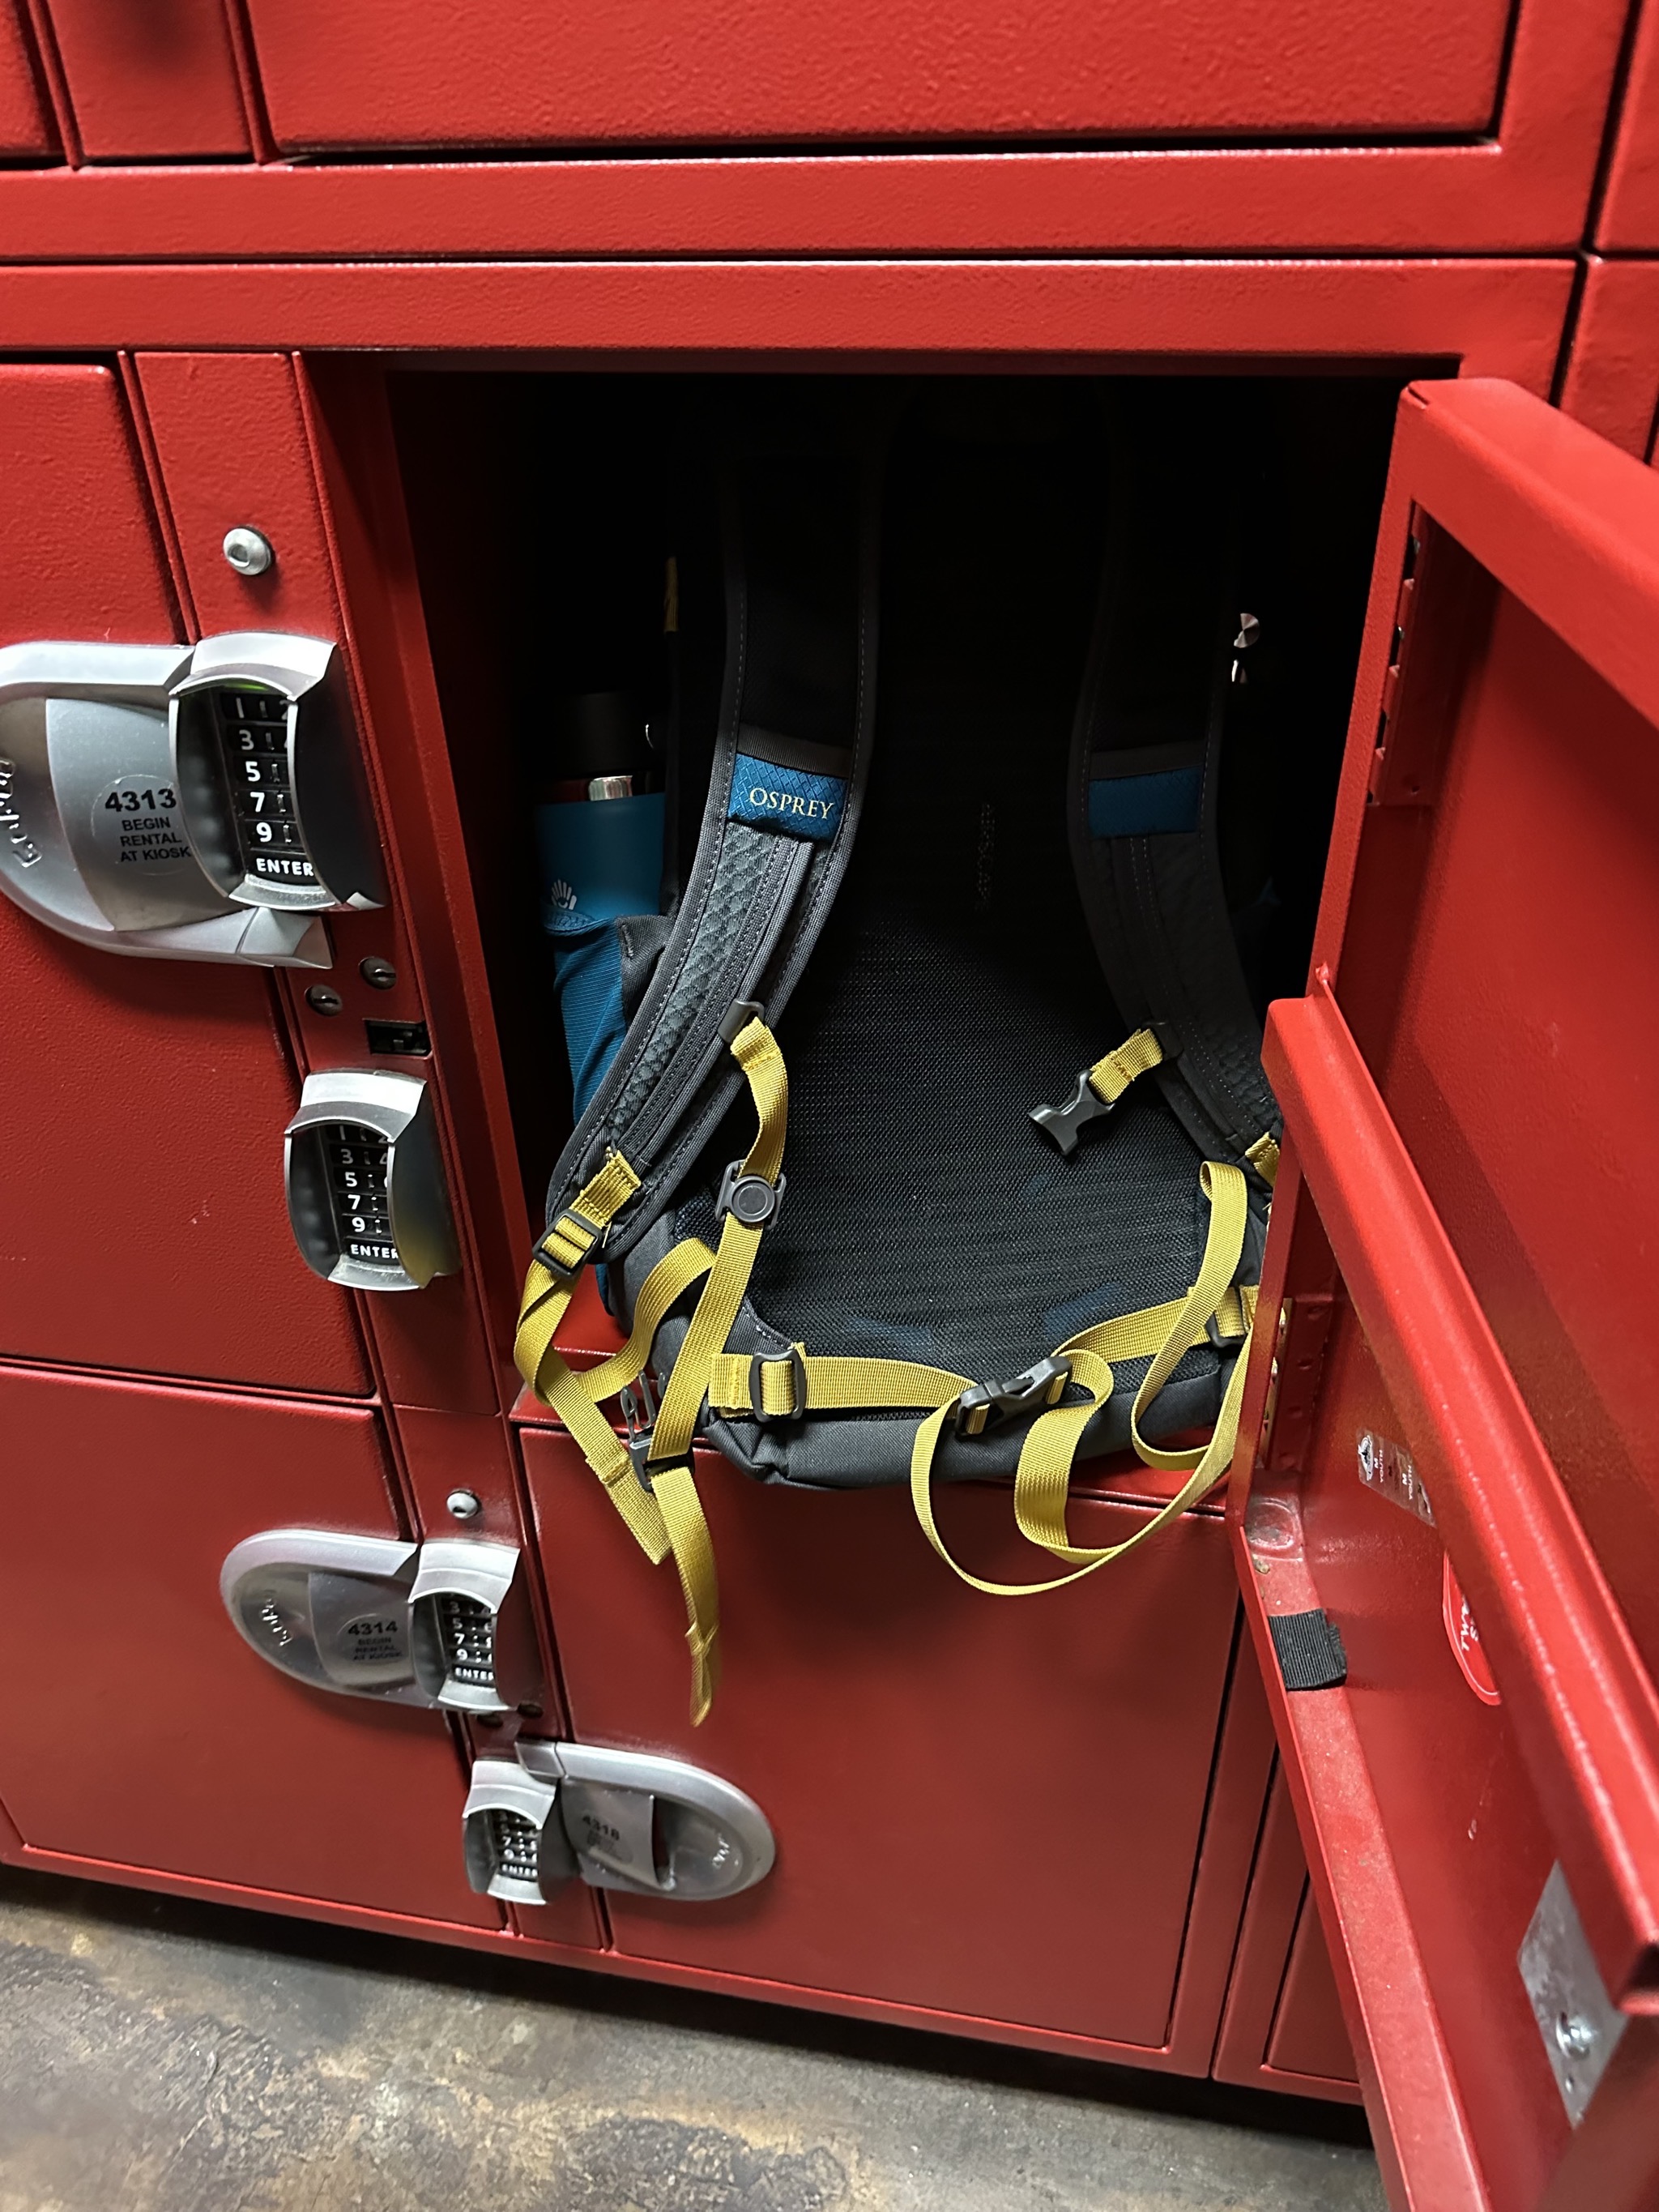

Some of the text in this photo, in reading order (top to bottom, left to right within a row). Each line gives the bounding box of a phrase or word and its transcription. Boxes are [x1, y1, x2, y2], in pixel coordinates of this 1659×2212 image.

[239, 729, 254, 750] 3
[245, 761, 261, 782] 5
[104, 788, 177, 812] 4313
[249, 791, 265, 812] 7
[749, 787, 834, 819] OSPREY
[122, 816, 171, 831] BEGIN
[119, 832, 182, 847] RENTAL
[256, 822, 272, 842] 9
[121, 846, 191, 862] AT KIOSK
[256, 857, 314, 876] ENTER
[341, 1148, 354, 1164] 3
[345, 1172, 357, 1187] 5
[348, 1194, 360, 1210] 7
[352, 1216, 365, 1232] 9
[350, 1244, 399, 1259] ENTER
[348, 1621, 398, 1635] 4314
[453, 1617, 463, 1629] 5
[454, 1633, 465, 1645] 7
[456, 1648, 467, 1660] 9
[455, 1668, 494, 1680] ENTER
